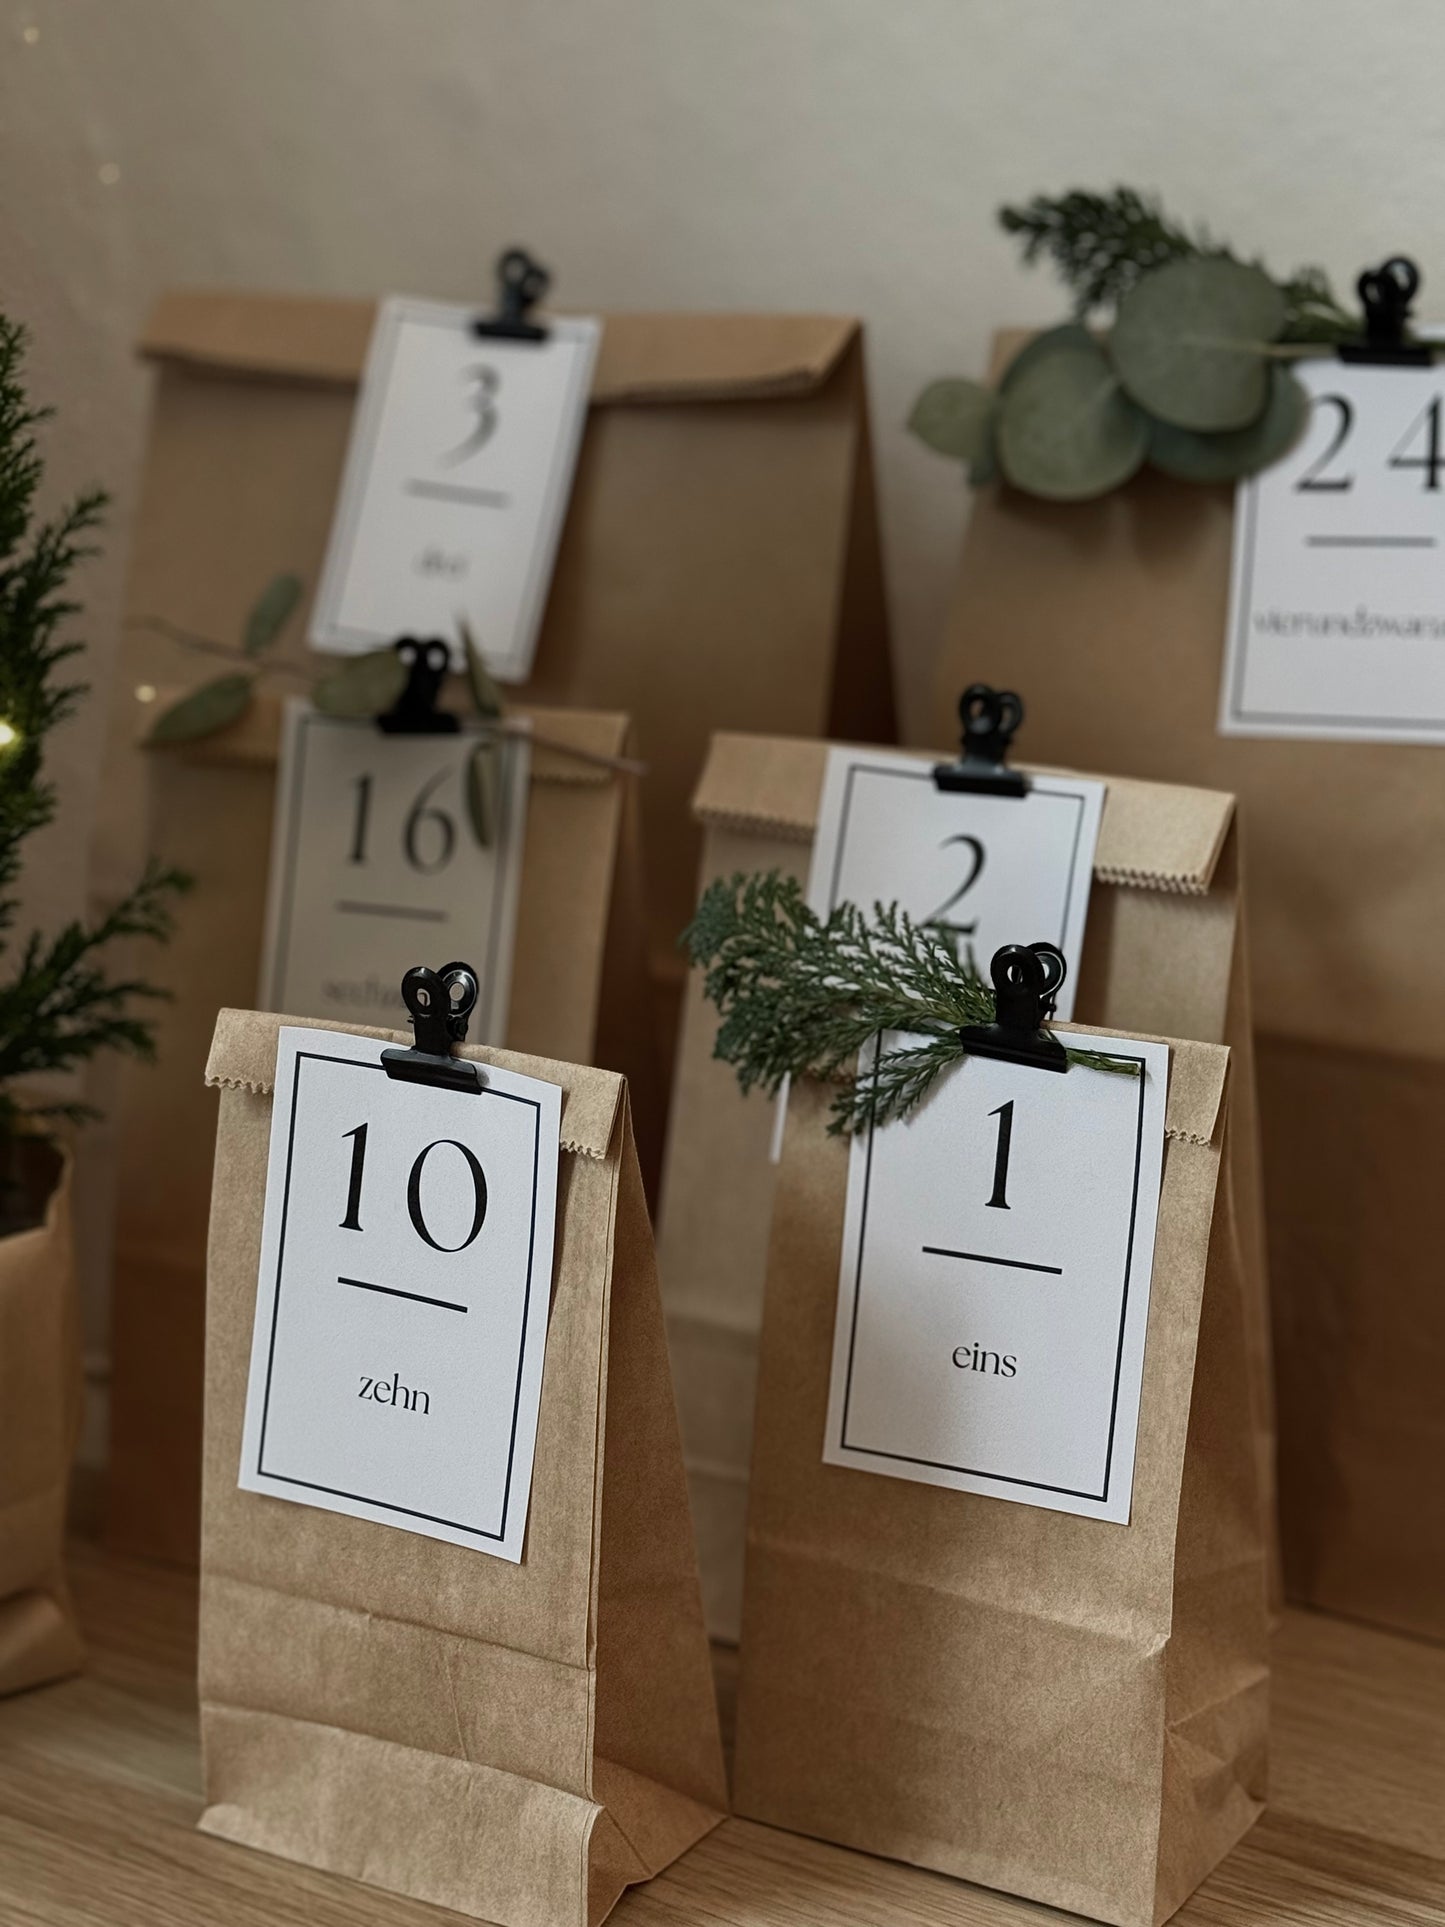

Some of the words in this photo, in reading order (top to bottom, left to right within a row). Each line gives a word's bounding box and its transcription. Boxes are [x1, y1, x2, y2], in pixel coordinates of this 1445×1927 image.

[438, 361, 501, 470] 3
[1294, 391, 1445, 493] 24
[348, 765, 457, 875] 16
[920, 832, 988, 934] 2
[338, 1121, 488, 1253] 10
[984, 1098, 1014, 1210] 1
[358, 1373, 431, 1416] zehn
[951, 1341, 1018, 1378] eins
